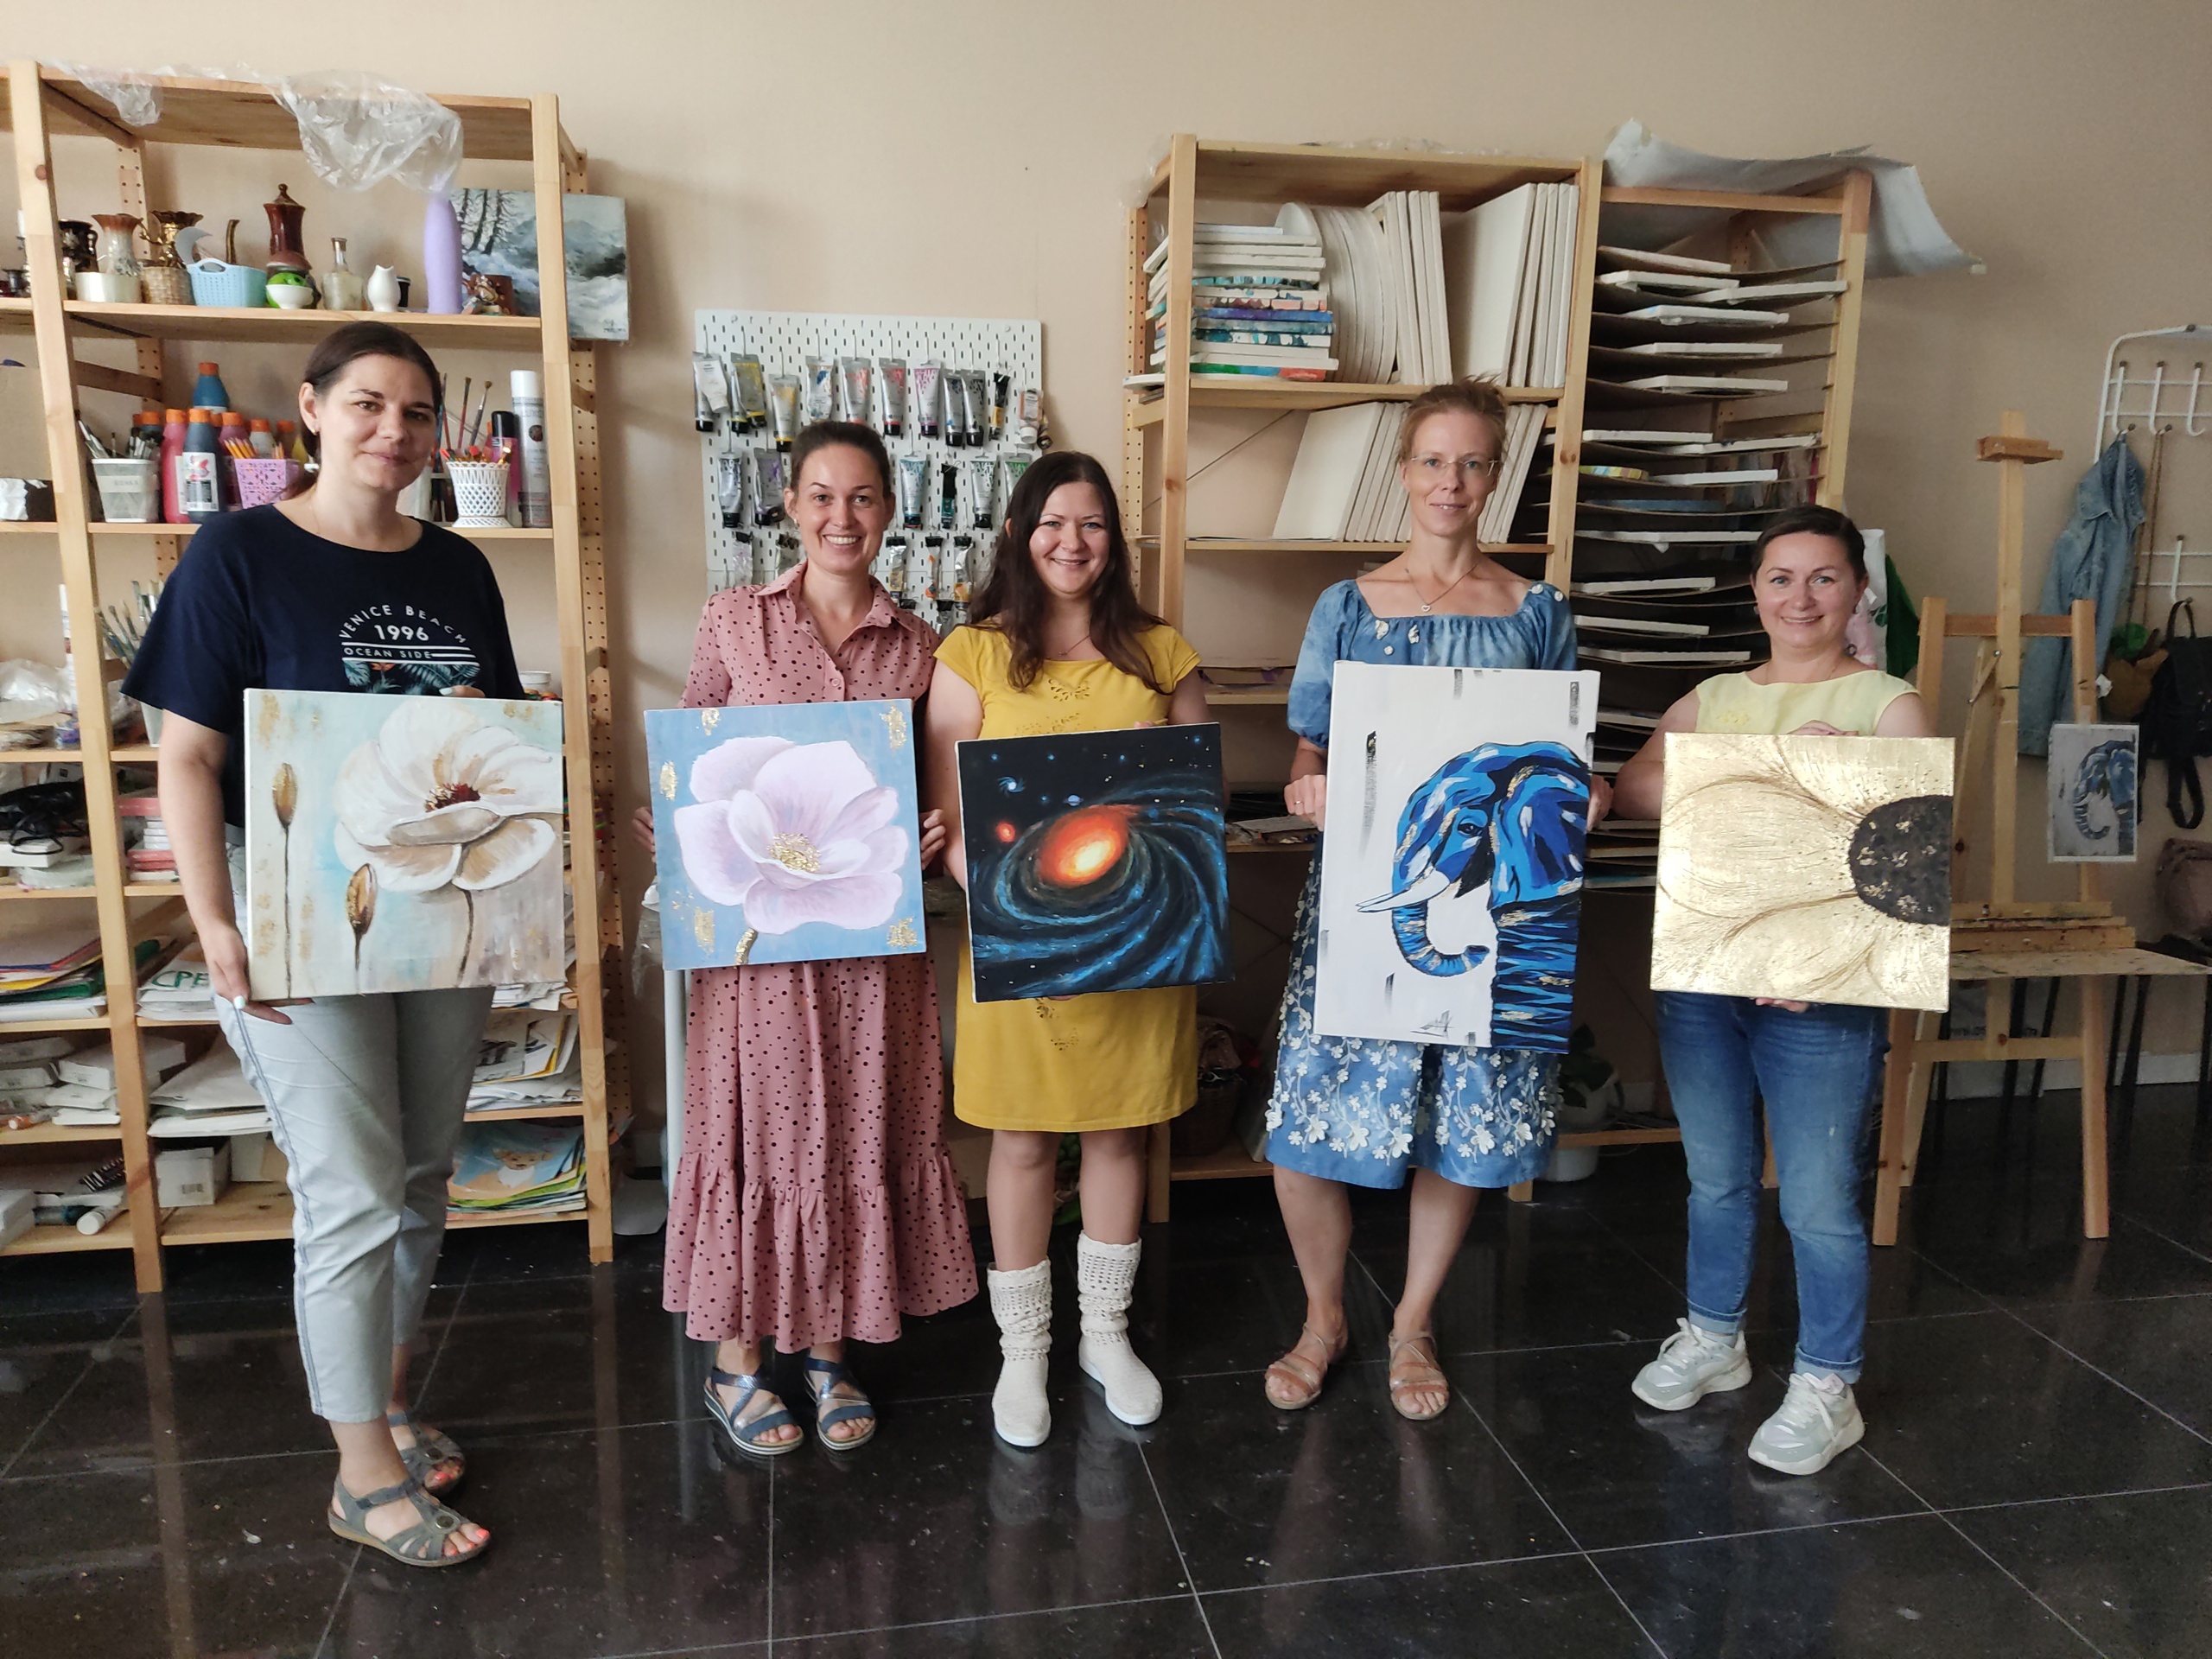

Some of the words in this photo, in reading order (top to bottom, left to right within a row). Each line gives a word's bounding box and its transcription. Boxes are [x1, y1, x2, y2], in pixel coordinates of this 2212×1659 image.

[338, 604, 393, 639] VENICE
[405, 605, 467, 644] BEACH
[373, 624, 429, 641] 1996
[343, 646, 393, 658] OCEAN
[400, 650, 432, 659] SIDE
